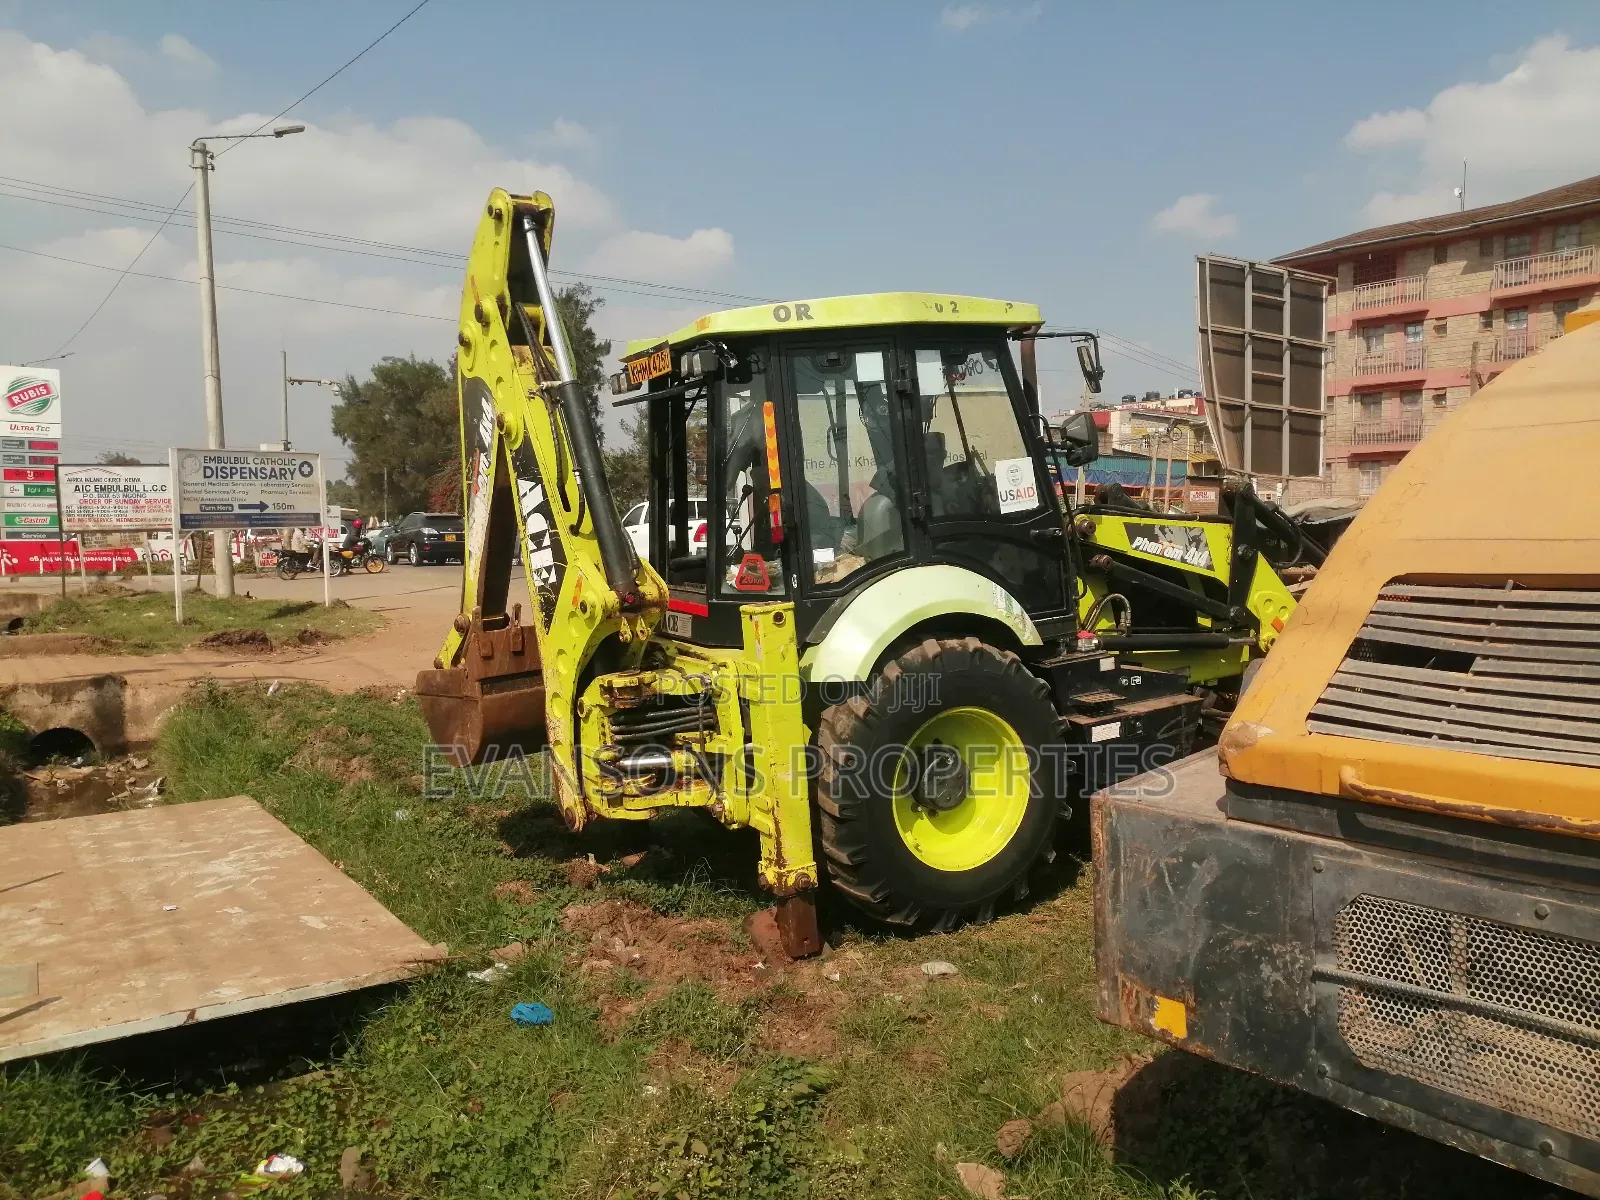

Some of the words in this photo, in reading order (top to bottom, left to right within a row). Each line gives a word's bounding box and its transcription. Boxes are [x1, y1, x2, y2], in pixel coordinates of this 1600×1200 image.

[773, 304, 814, 322] OR
[11, 386, 47, 404] RUBIS
[203, 456, 250, 465] EMBULBUL
[253, 458, 297, 466] CATHOLIC
[804, 457, 825, 469] The
[203, 465, 297, 480] DISPENSARY
[74, 484, 91, 492] AIC
[94, 484, 140, 492] EMBULBUL
[1000, 486, 1036, 502] USAID
[272, 502, 295, 510] 150m
